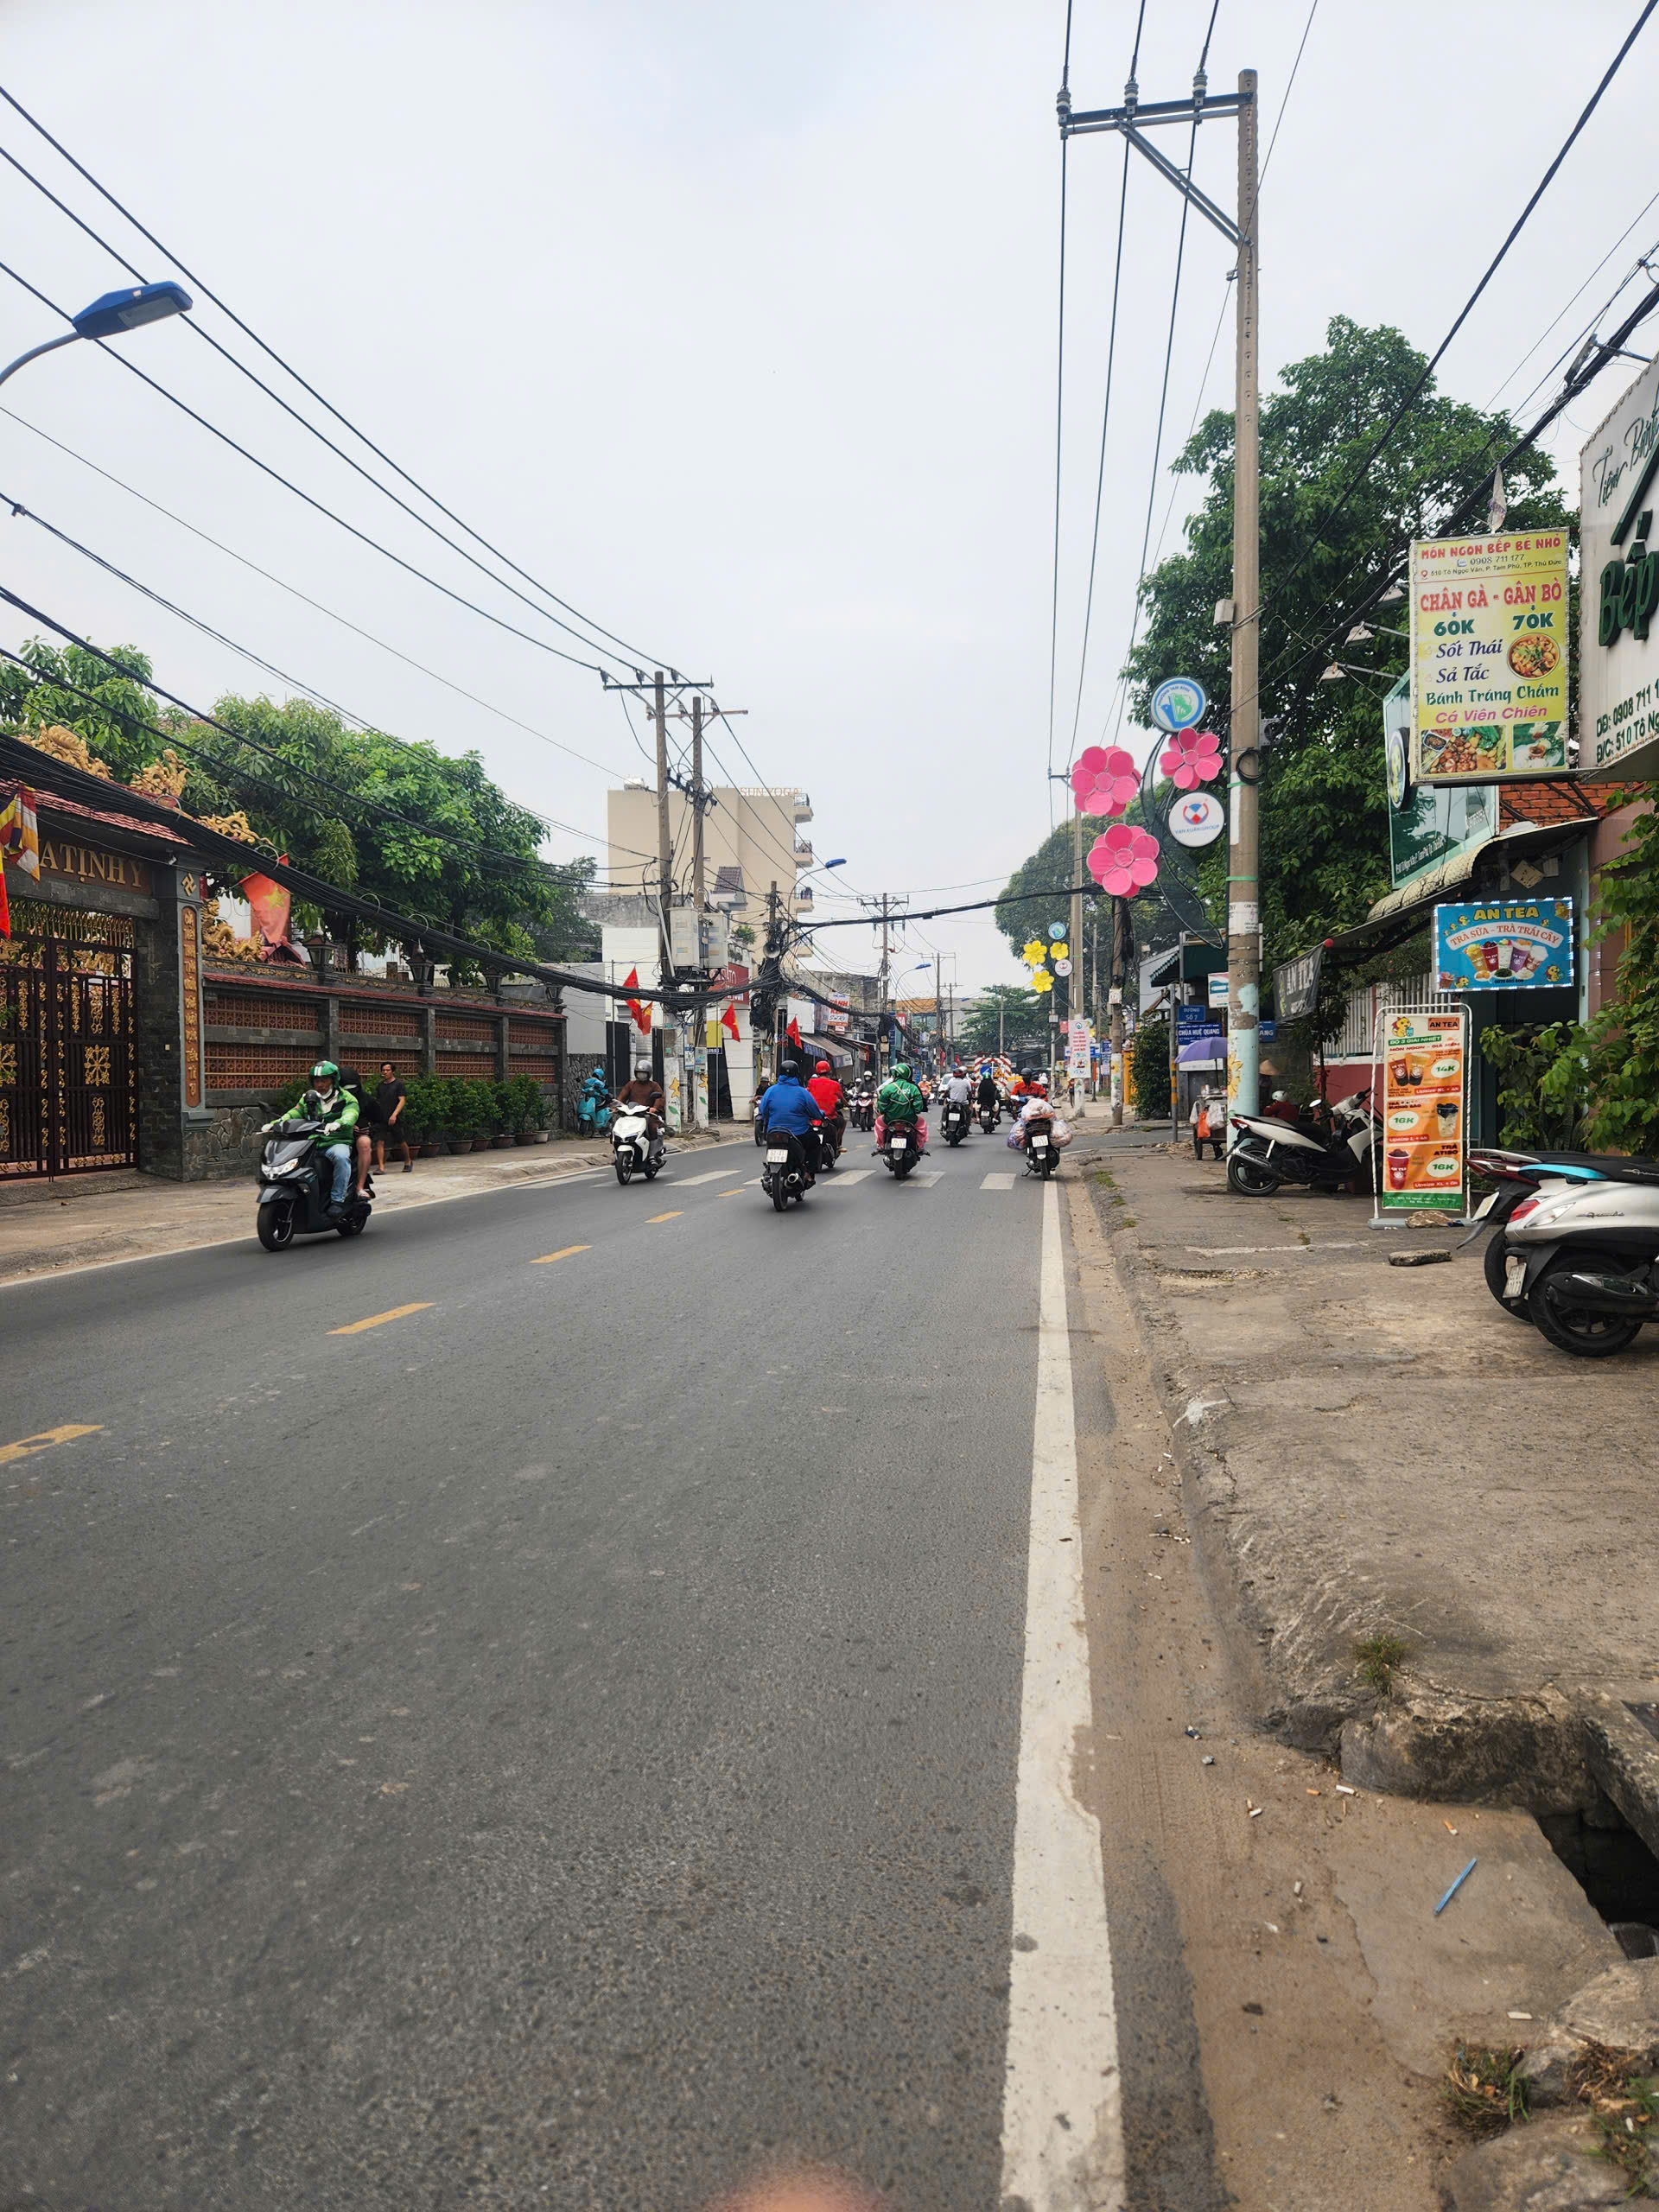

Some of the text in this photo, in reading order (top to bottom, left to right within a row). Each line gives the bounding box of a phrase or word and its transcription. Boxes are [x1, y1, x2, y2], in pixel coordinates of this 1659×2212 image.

[1421, 533, 1561, 560] MÓN NGON BẾP BÉ NHỎ
[1470, 556, 1492, 565] 0908
[1420, 587, 1462, 613] CHÂN
[1467, 583, 1489, 608] GÀ
[1503, 581, 1536, 605] GÂN
[1541, 577, 1562, 602] BÒ
[1433, 612, 1554, 637] 60K 70K
[1436, 639, 1503, 658] Sốt Thái
[1436, 664, 1490, 683] Sả Tắc
[1426, 683, 1560, 705] Bánh Tráng Chấm
[1612, 697, 1633, 726] 0908
[1636, 684, 1651, 711] 711
[1435, 705, 1548, 724] Cá Viên Chiên
[1616, 726, 1632, 751] 510
[1633, 717, 1645, 741] Tô
[60, 842, 126, 883] TỊNH
[1473, 906, 1539, 921] AN TEA
[1450, 933, 1470, 946] TRÀ
[1470, 925, 1490, 938] SỮA
[1496, 923, 1516, 933] TRÀ
[1517, 924, 1539, 938] TRÁI
[1541, 931, 1560, 944] CÂY
